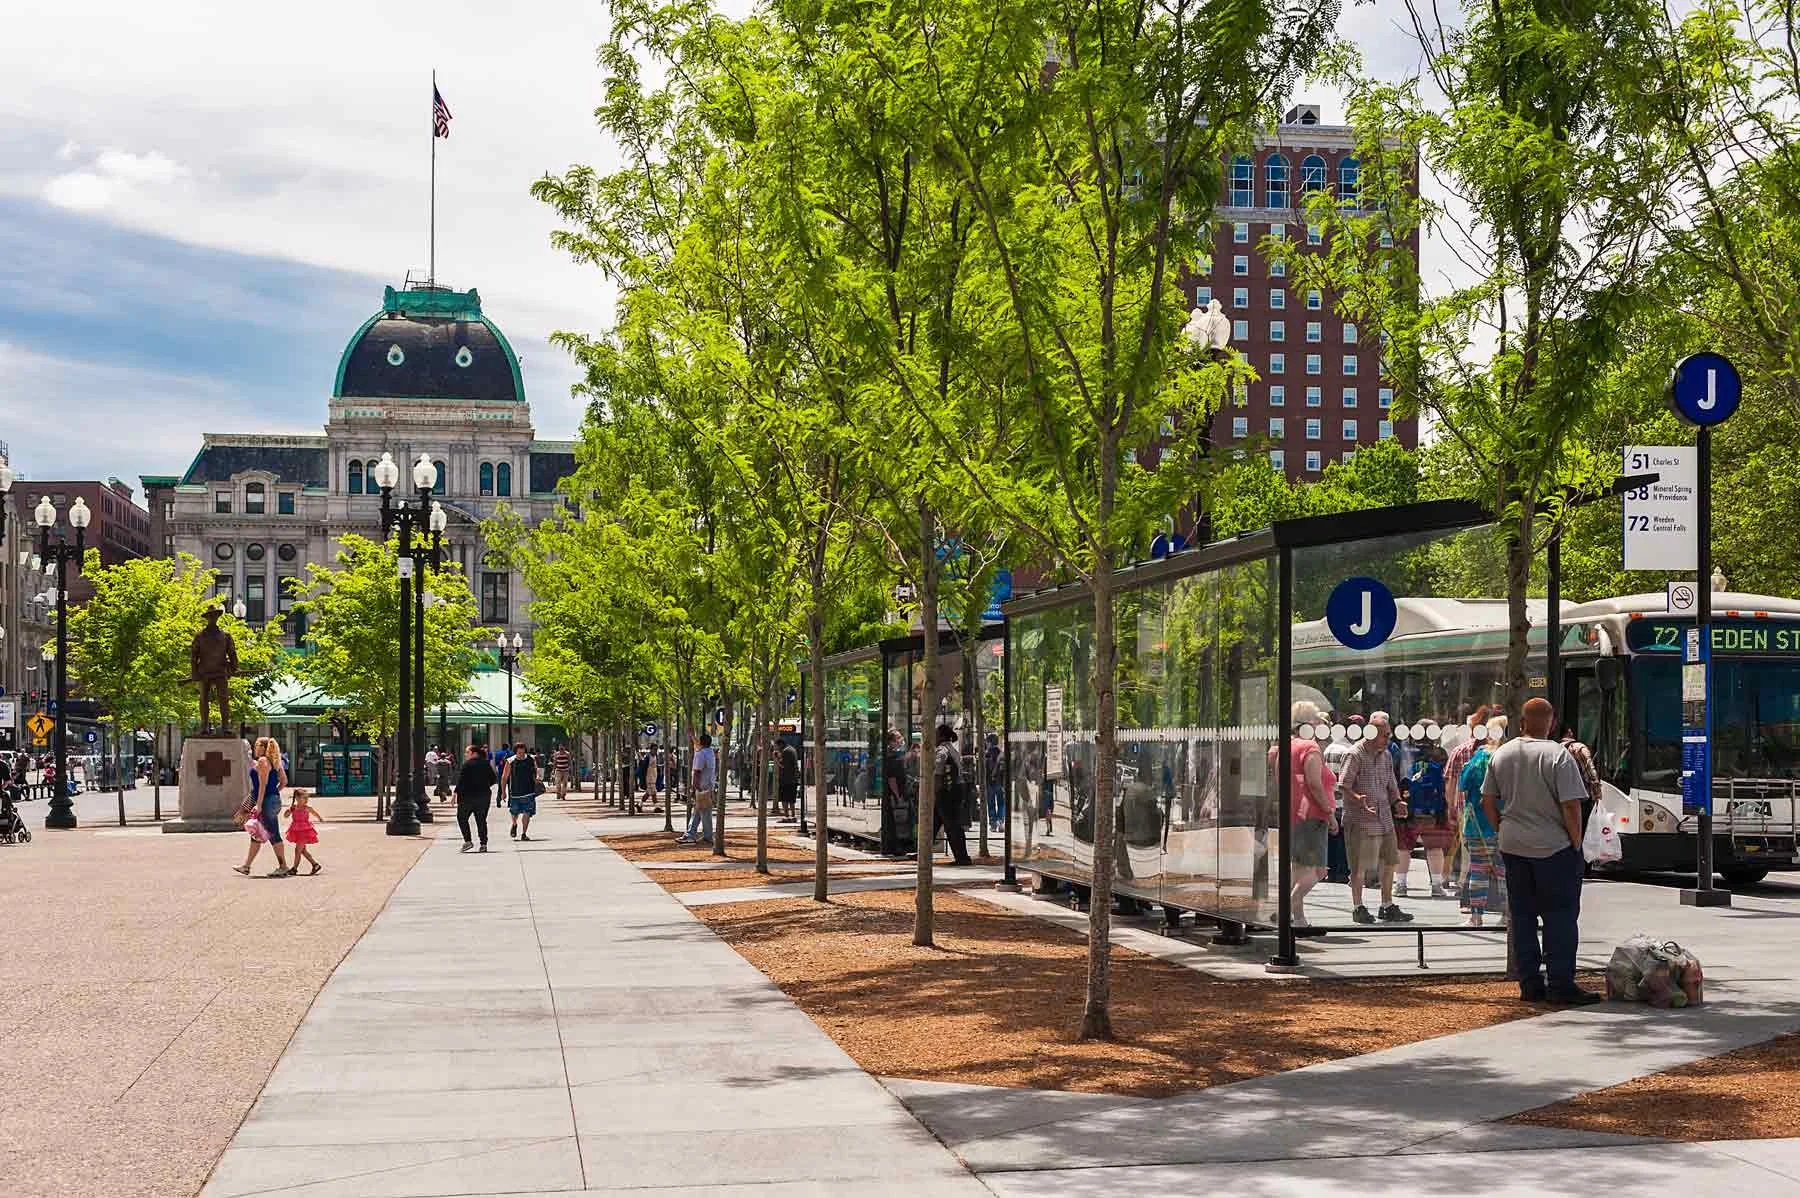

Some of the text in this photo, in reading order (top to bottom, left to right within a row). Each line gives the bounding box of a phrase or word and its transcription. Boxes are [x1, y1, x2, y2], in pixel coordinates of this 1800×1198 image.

[1697, 369, 1716, 410] J
[1632, 454, 1649, 469] 51
[1653, 458, 1679, 466] Charles St
[1627, 484, 1649, 501] 58
[1674, 485, 1692, 494] Spring
[1628, 516, 1649, 531] 72
[1350, 591, 1371, 636] J
[1653, 627, 1679, 645] 72
[1712, 629, 1768, 649] EDEN
[646, 725, 655, 734] G
[88, 734, 95, 742] B
